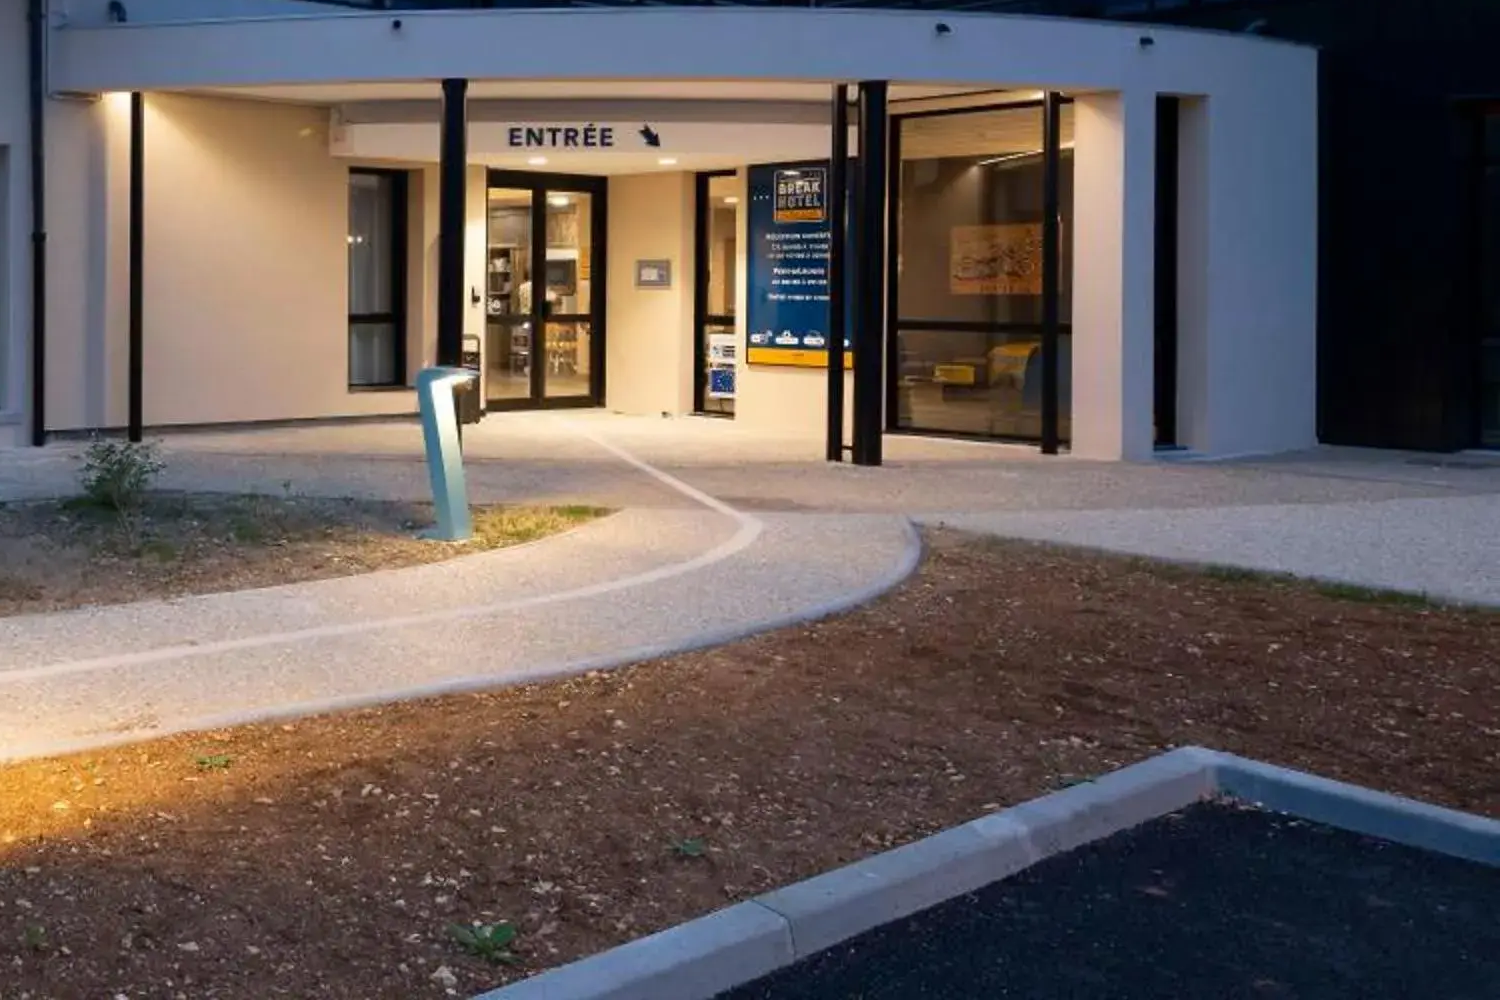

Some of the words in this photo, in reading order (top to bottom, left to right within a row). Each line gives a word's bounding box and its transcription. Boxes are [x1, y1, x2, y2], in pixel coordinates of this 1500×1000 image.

[508, 123, 615, 147] ENTRÉE
[777, 181, 821, 195] BREAK
[777, 193, 821, 208] HOTEL
